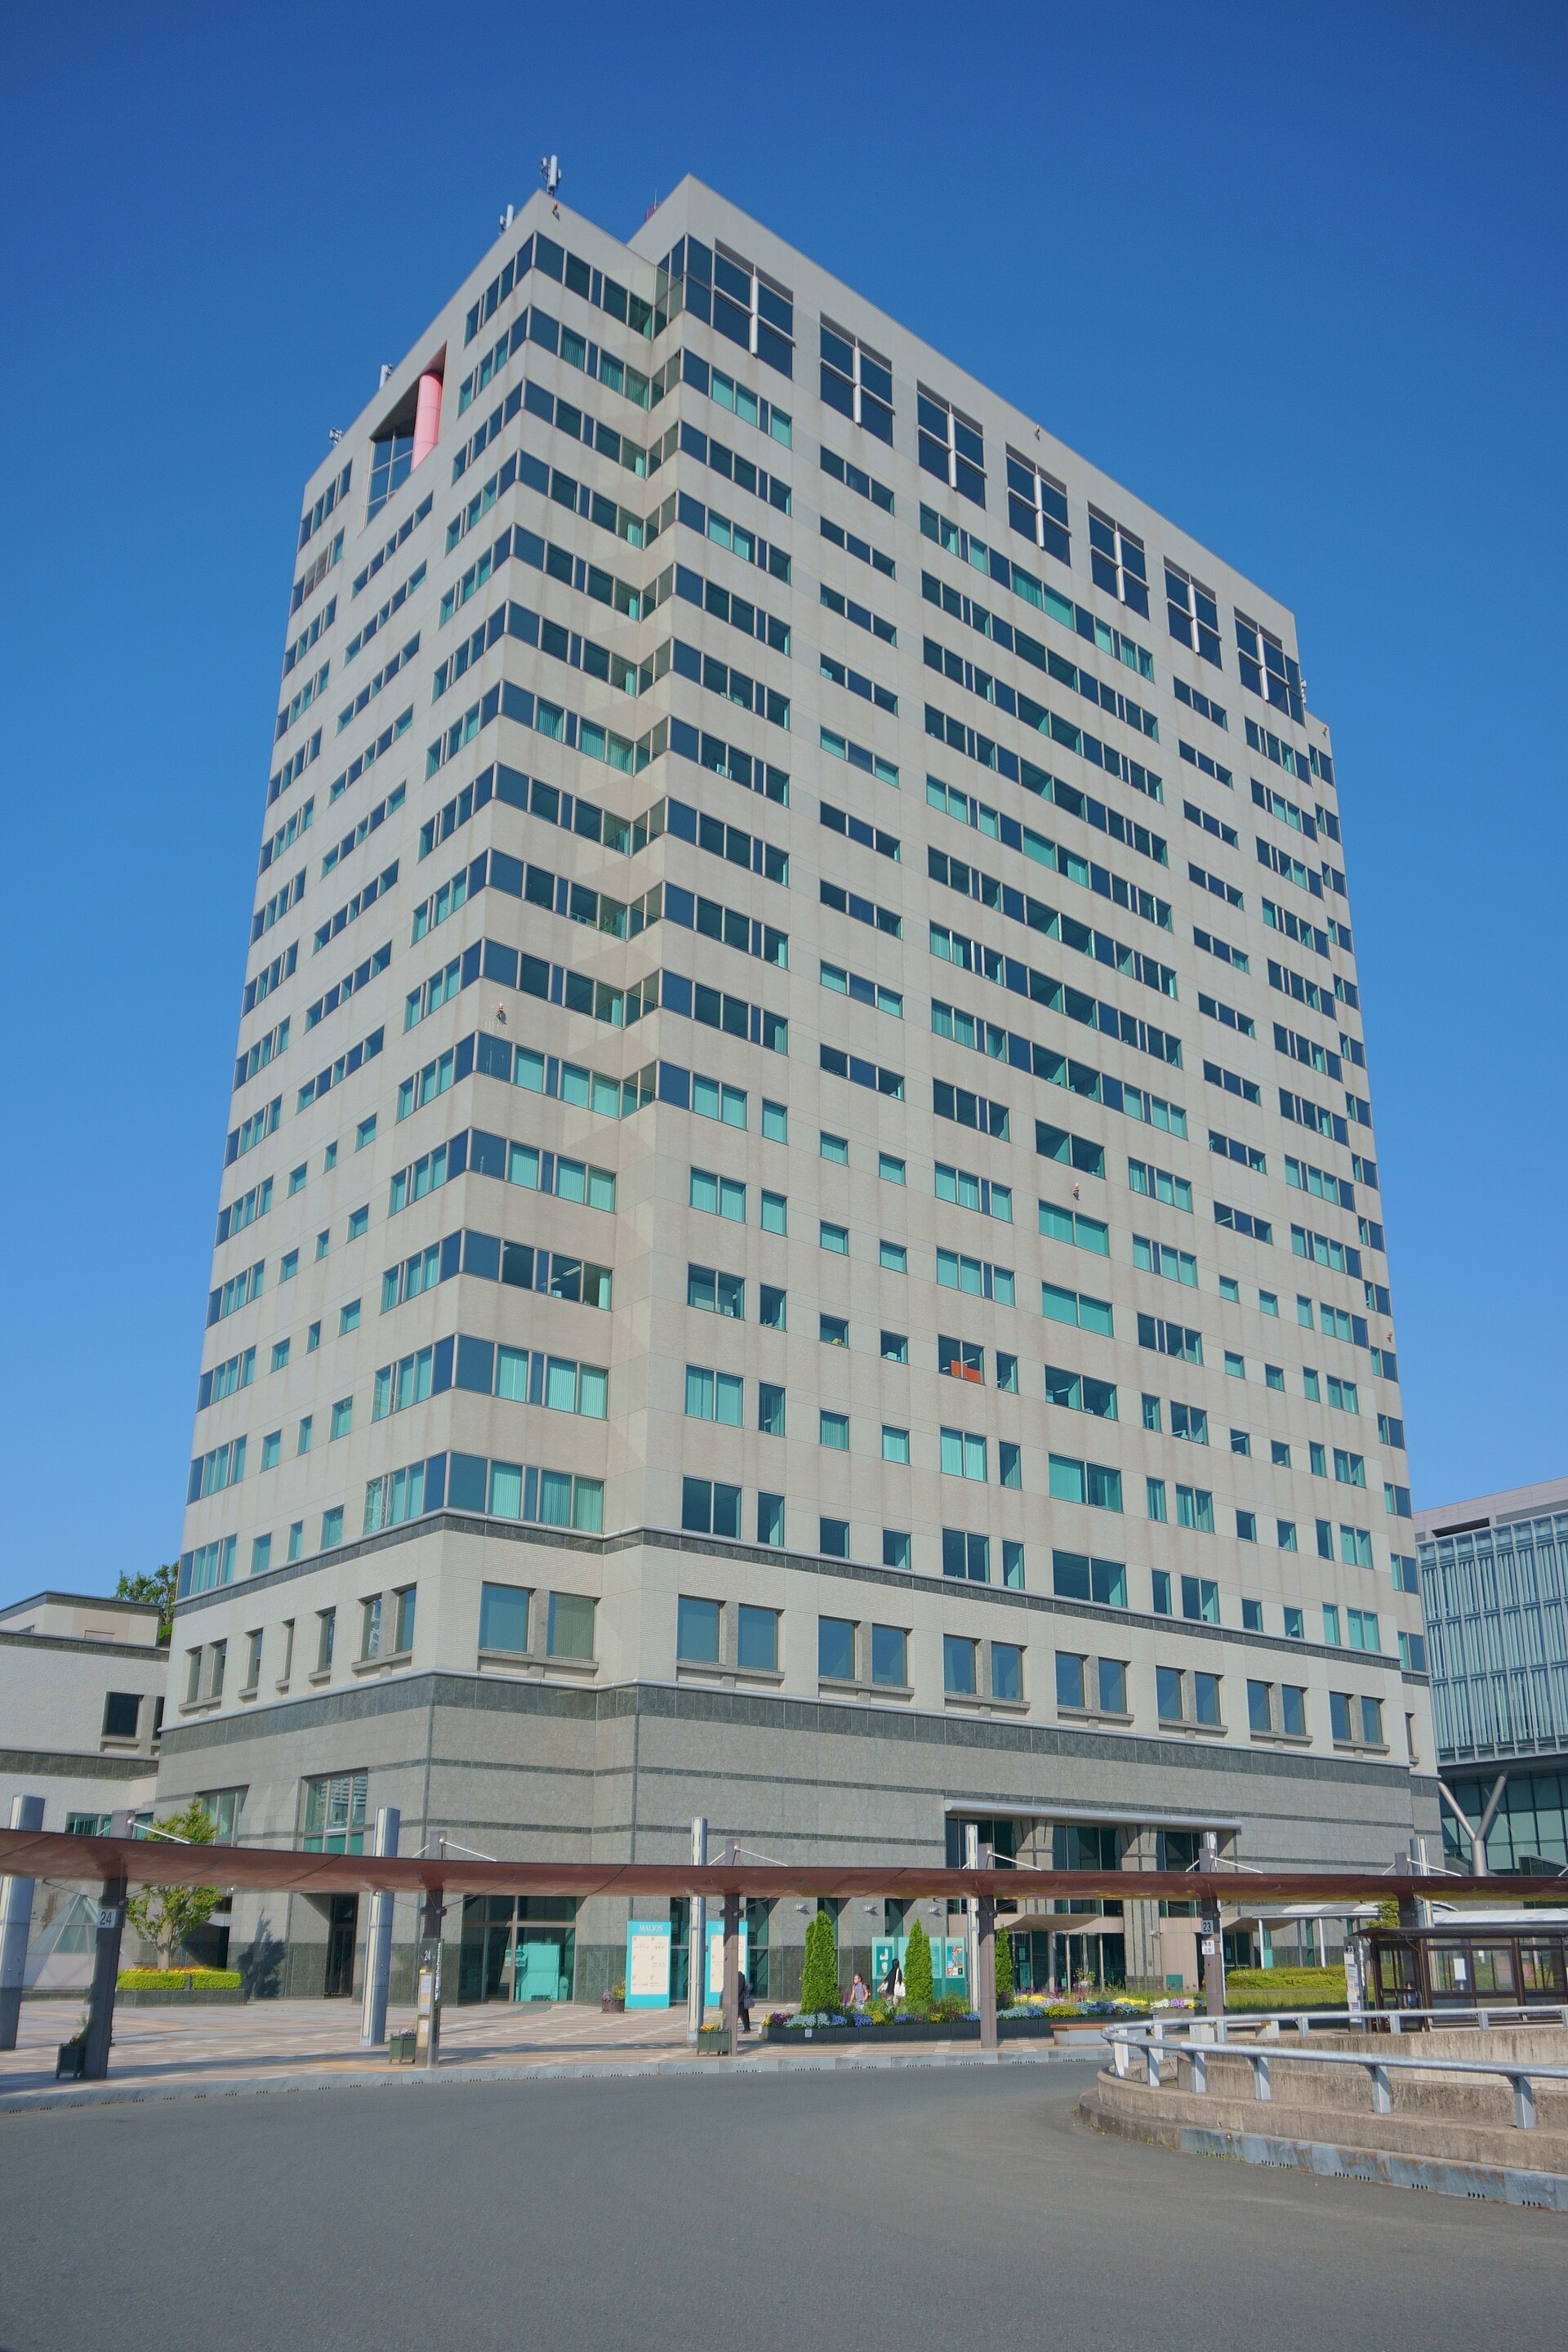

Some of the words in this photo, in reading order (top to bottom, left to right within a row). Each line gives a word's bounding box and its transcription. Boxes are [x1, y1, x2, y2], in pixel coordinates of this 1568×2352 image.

[100, 1911, 112, 1926] 24
[1202, 1922, 1211, 1932] 23
[424, 1949, 431, 1961] 24
